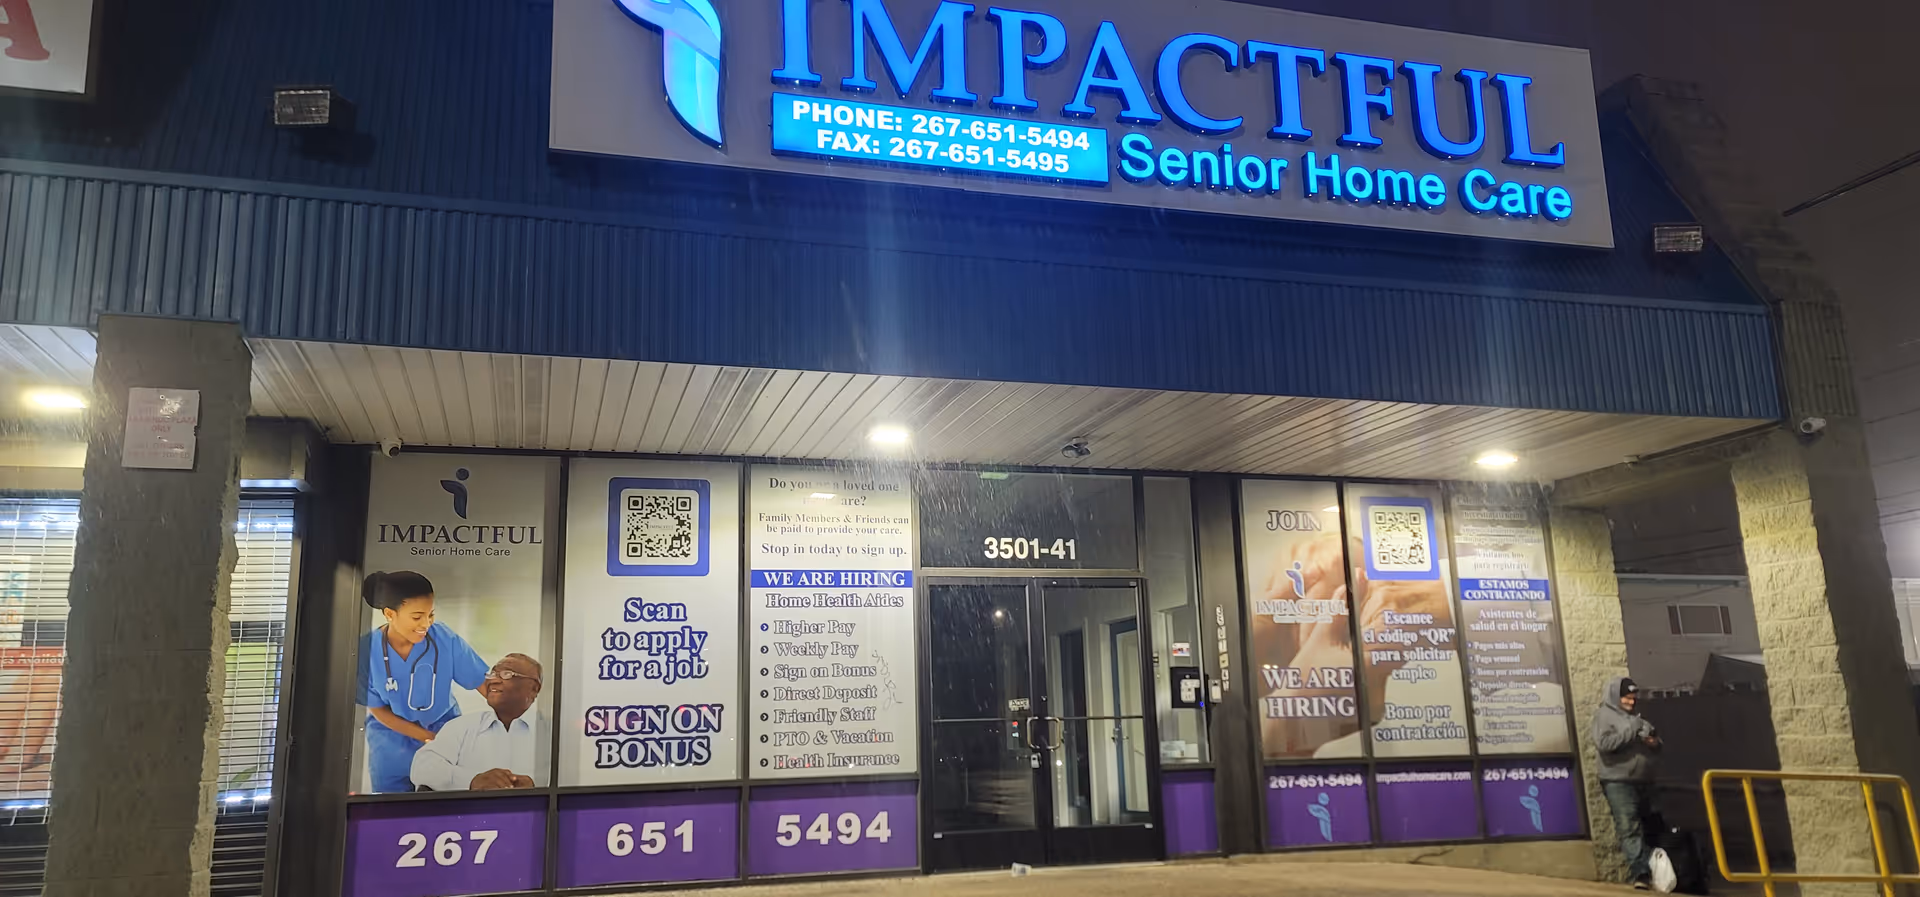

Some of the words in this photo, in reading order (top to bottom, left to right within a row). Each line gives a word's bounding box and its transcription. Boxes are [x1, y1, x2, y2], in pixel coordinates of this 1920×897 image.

[772, 0, 1565, 167] IMPACTFUL
[792, 101, 903, 132] PHONE:
[911, 114, 1090, 151] 267-651-5494
[817, 130, 881, 155] FAX:
[888, 136, 1070, 173] 267-651-5495
[1119, 132, 1289, 193] Senior
[1307, 151, 1447, 208] Home
[1459, 168, 1573, 221] Care
[769, 477, 787, 489] Do
[843, 480, 875, 491] loved
[878, 483, 900, 492] one
[840, 495, 867, 507] are?
[758, 513, 793, 523] Family
[795, 513, 841, 523] Members
[843, 514, 853, 524] &
[855, 514, 891, 524] Friends
[893, 517, 910, 525] can
[1266, 509, 1322, 532] JOIN
[378, 524, 543, 545] IMPACTFUL
[766, 524, 778, 533] be
[780, 524, 802, 535] paid
[804, 526, 814, 534] to
[816, 525, 854, 536] provide
[855, 527, 878, 536] your
[410, 547, 446, 556] Senior
[450, 547, 481, 556] Home
[485, 547, 511, 557] Care
[761, 543, 790, 557] Stop
[793, 544, 806, 554] in
[809, 544, 843, 557] today
[846, 545, 858, 555] to
[861, 544, 885, 557] sign
[889, 547, 907, 557] up.
[984, 537, 1076, 560] 3501-41
[763, 571, 793, 586] WE
[796, 571, 835, 586] ARE
[839, 571, 906, 586] HIRING
[1478, 579, 1530, 590] ESTAMOS
[766, 593, 811, 608] Home
[813, 592, 862, 608] Health
[864, 592, 904, 608] Aides
[1463, 589, 1546, 600] CONTRATANDO
[624, 597, 688, 622] Scan
[1256, 599, 1349, 616] IMPACTFUL
[1479, 608, 1523, 619] Asistentes
[1526, 608, 1537, 619] de
[773, 620, 825, 637] Higher
[828, 620, 856, 637] Pay
[1470, 621, 1496, 631] salud
[1497, 623, 1508, 631] en
[1510, 621, 1519, 631] el
[1521, 621, 1548, 633] hogar
[601, 627, 631, 651] to
[634, 626, 708, 656] apply
[1363, 630, 1375, 643] el
[1378, 629, 1418, 645] código
[773, 642, 829, 659] Weekly
[831, 641, 860, 658] Pay
[1371, 651, 1401, 665] para
[1403, 647, 1453, 661] solicitar
[599, 655, 642, 680] for
[644, 660, 662, 680] a
[663, 653, 709, 685] job
[773, 664, 807, 682] Sign
[810, 667, 829, 678] on
[831, 663, 877, 678] Bonus
[1261, 667, 1302, 690] WE
[1306, 666, 1355, 689] ARE
[1391, 666, 1437, 683] empleo
[773, 686, 821, 702] Direct
[822, 684, 877, 703] Deposit
[773, 708, 838, 725] Friendly
[839, 706, 877, 722] Staff
[1266, 696, 1355, 719] HIRING
[1385, 703, 1422, 720] Bono
[1424, 704, 1451, 723] por
[585, 705, 669, 736] SIGN
[671, 703, 724, 733] ON
[773, 731, 810, 747] PTO
[812, 731, 828, 746] &
[830, 729, 894, 744] Vacation
[1375, 722, 1467, 741] contratación
[595, 735, 712, 769] BONUS
[773, 754, 824, 770] Health
[827, 752, 900, 768] Insurance
[1269, 774, 1363, 789] 267-651-5494
[1483, 767, 1569, 781] 267-651-5494
[395, 830, 499, 868] 267
[606, 819, 695, 857] 651
[775, 811, 892, 848] 5494
